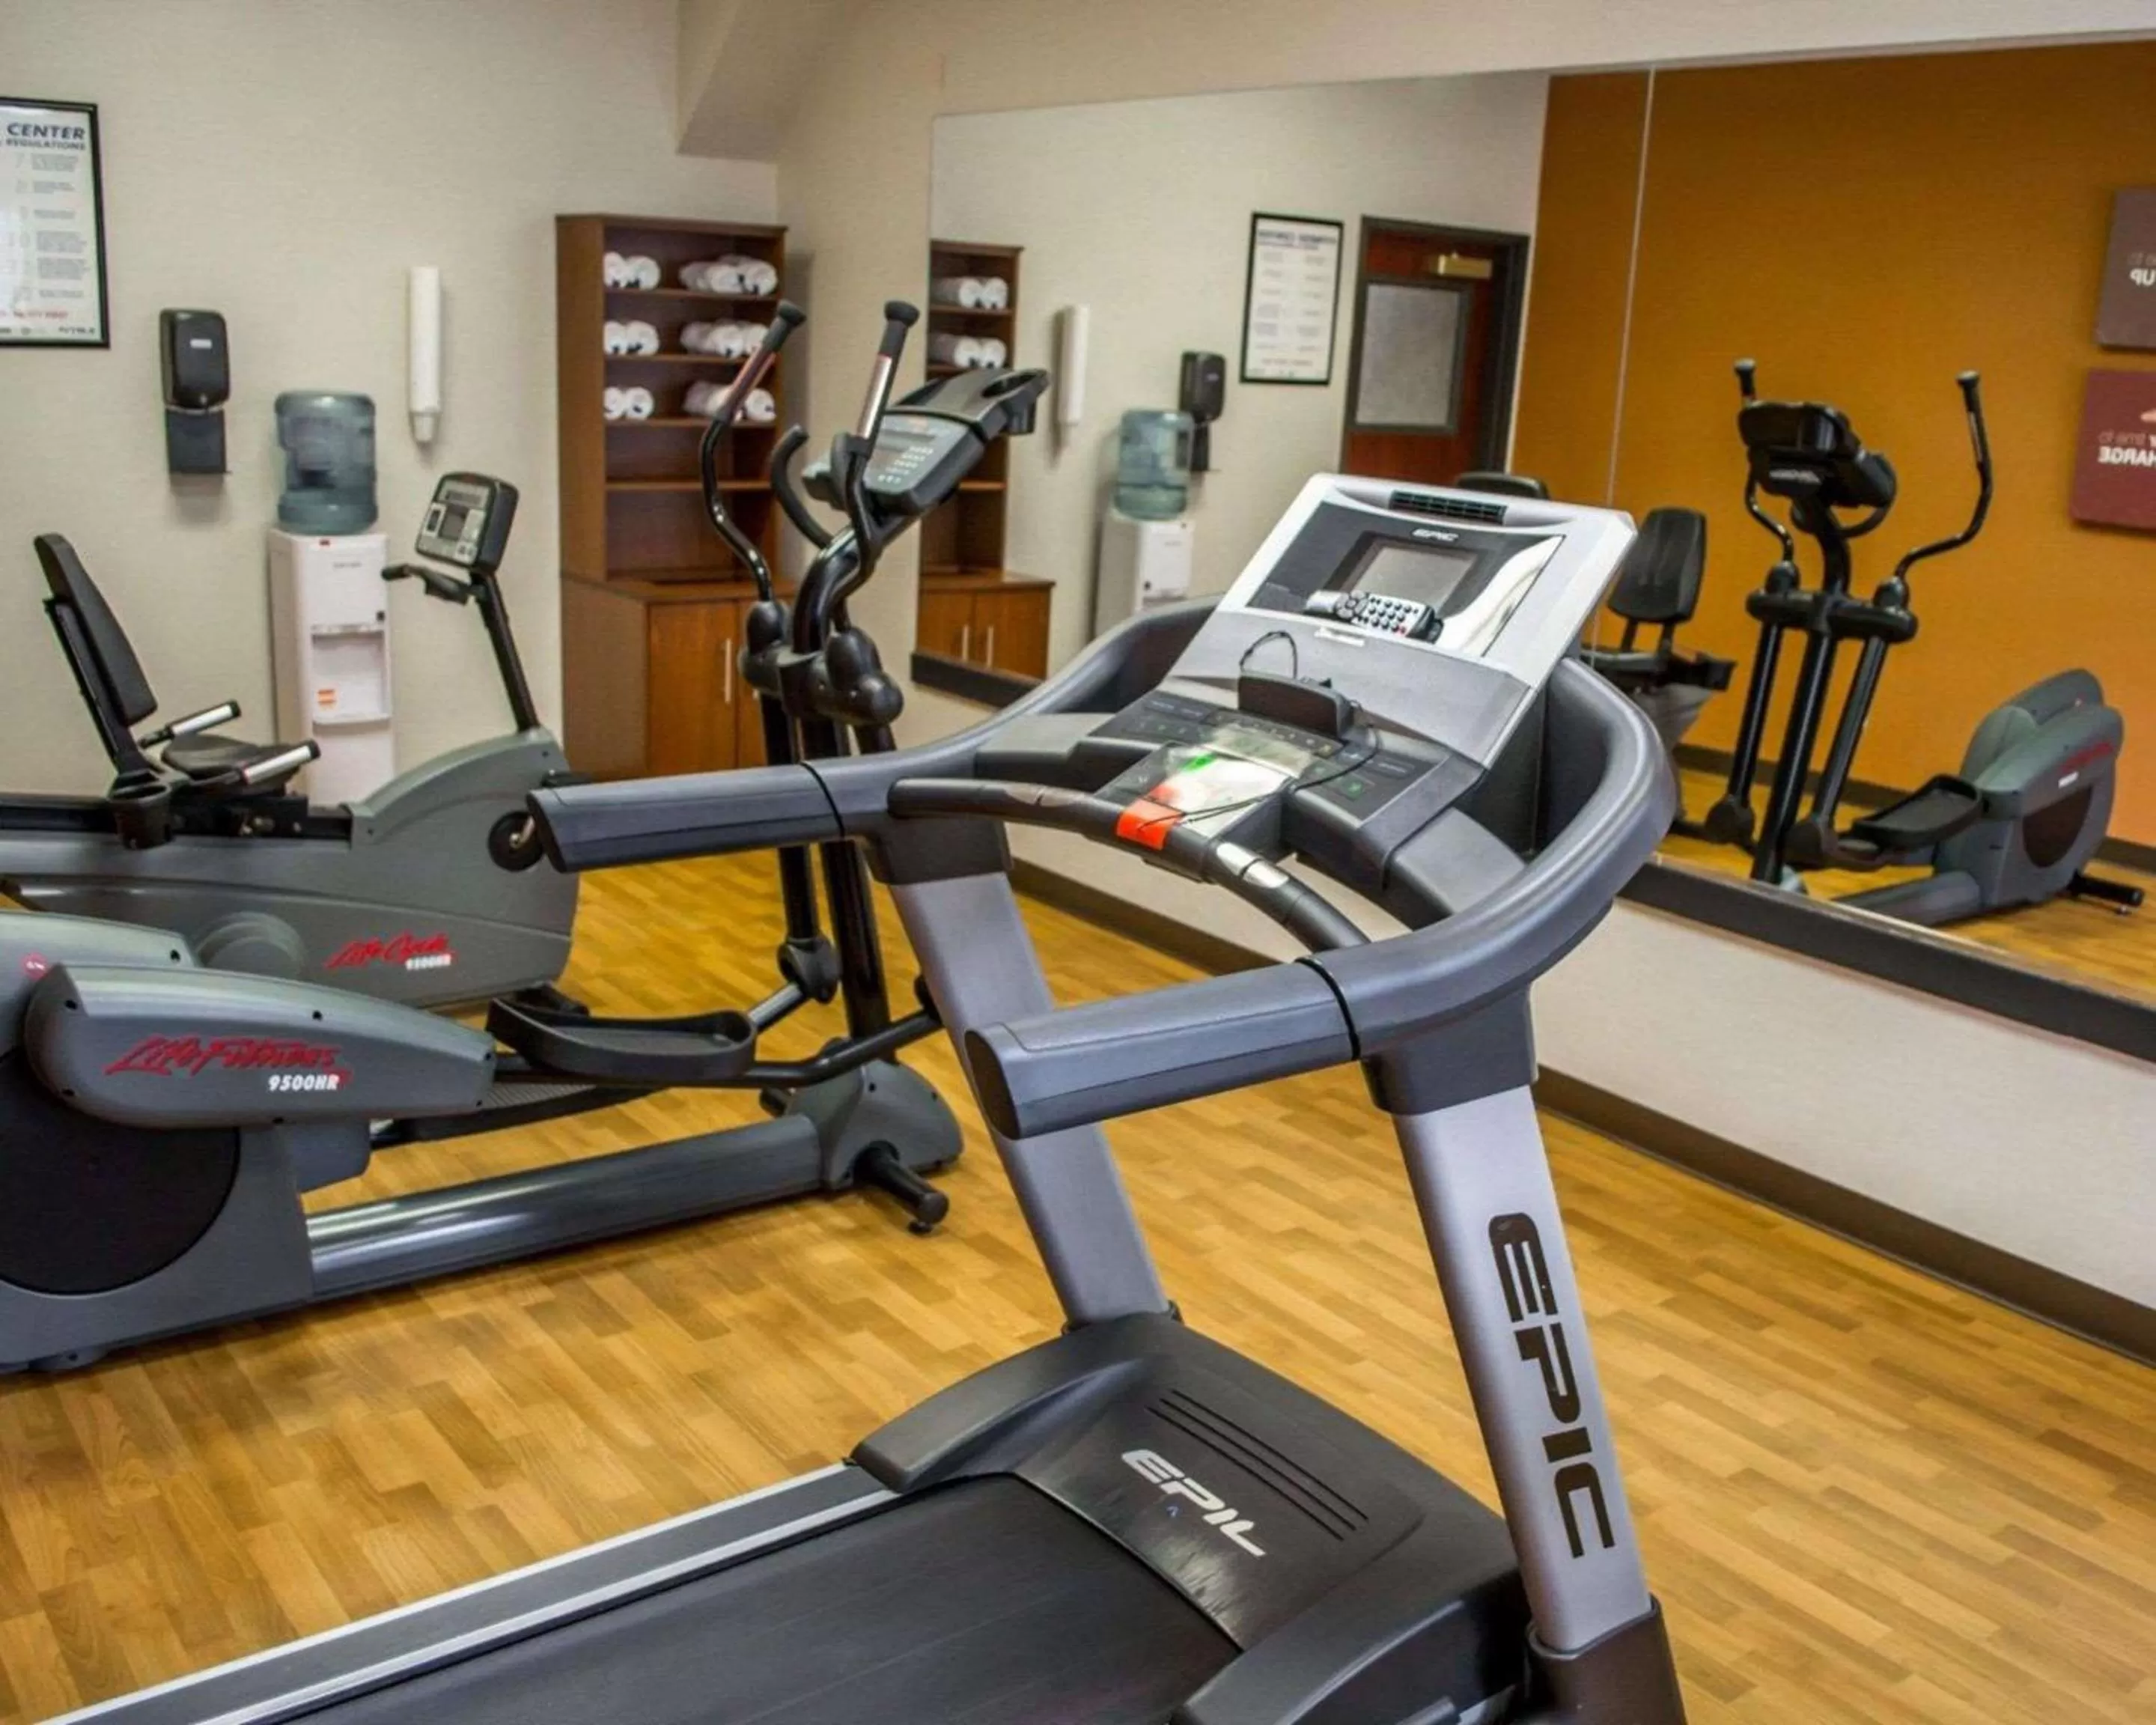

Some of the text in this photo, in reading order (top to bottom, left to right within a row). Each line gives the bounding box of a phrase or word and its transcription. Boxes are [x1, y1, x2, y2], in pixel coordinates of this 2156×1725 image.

[7, 123, 85, 139] CENTER
[268, 1074, 338, 1091] 9500HR
[1488, 1212, 1615, 1558] EPIC
